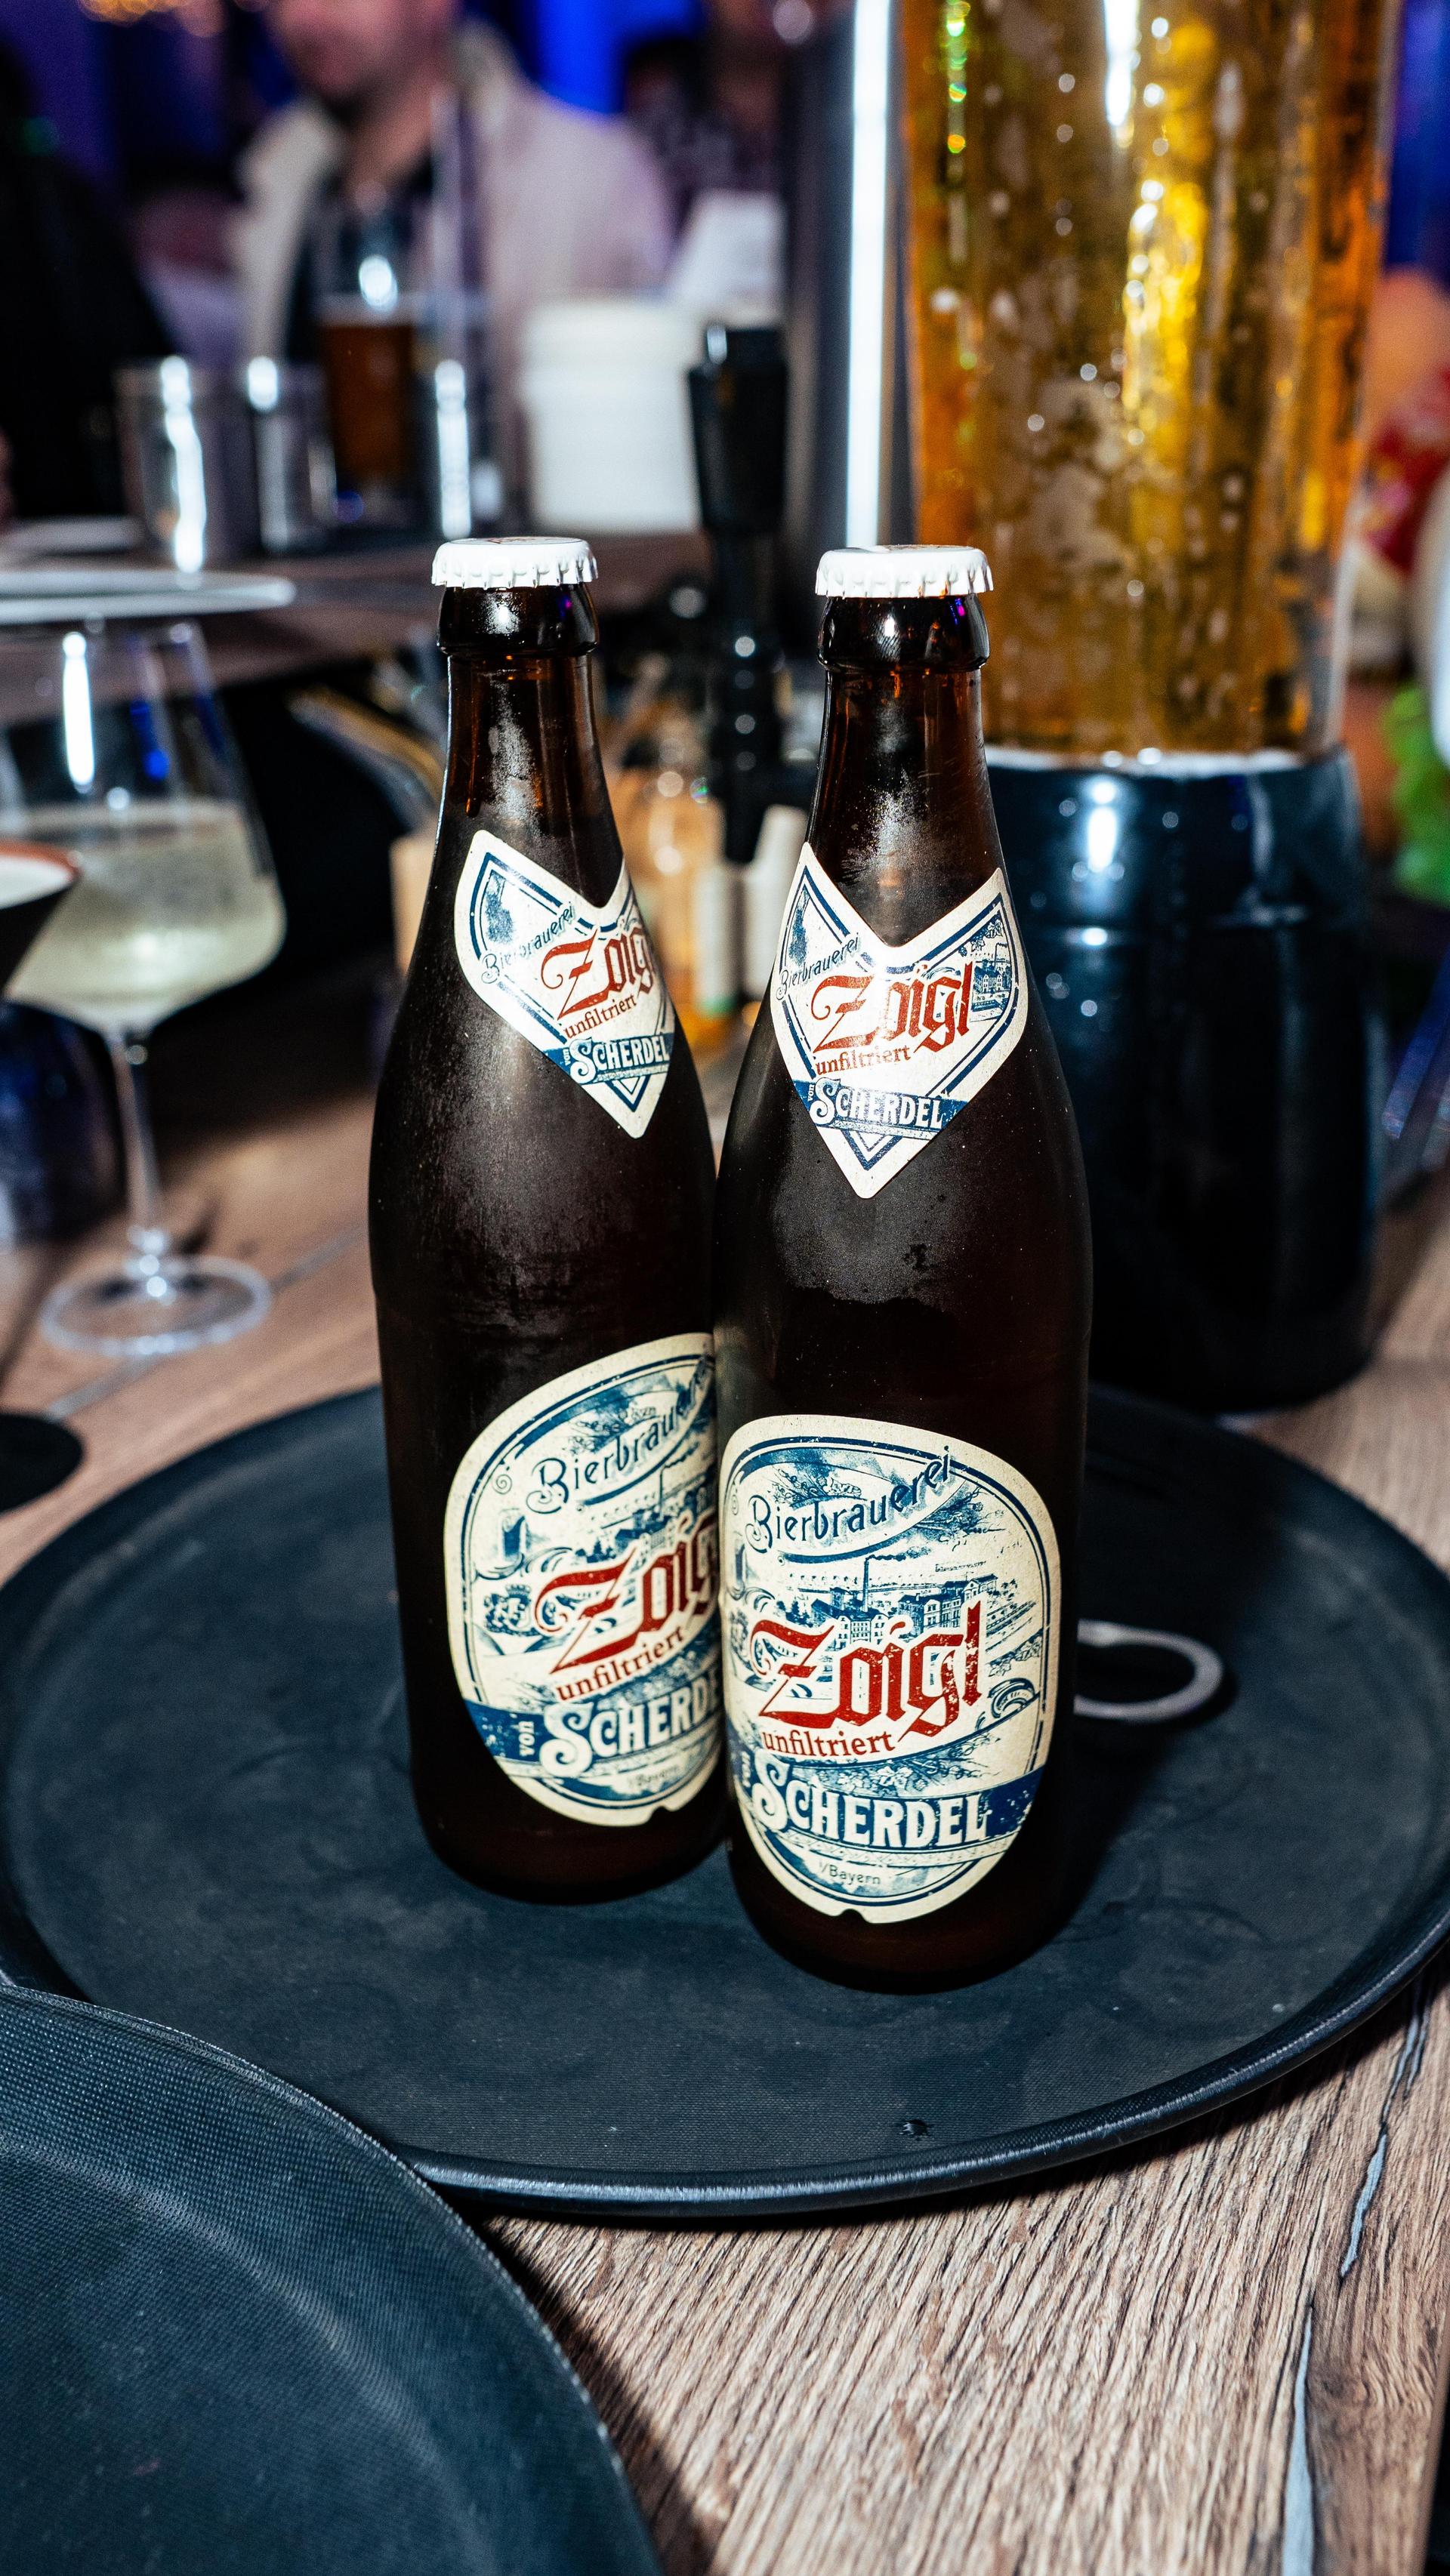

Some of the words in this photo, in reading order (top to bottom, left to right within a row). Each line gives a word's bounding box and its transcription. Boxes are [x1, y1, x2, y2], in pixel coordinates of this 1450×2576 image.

[776, 932, 859, 1000] Bierbrauerei
[565, 995, 637, 1040] unfiltriert
[810, 960, 973, 1054] Zoigl
[569, 1037, 670, 1084] SCHERDEL
[816, 1044, 912, 1075] unfiltriert
[809, 1077, 943, 1130] SCHERDEL
[745, 1445, 950, 1554] Bierbrauerei
[534, 1511, 717, 1675] Zoig
[556, 1626, 683, 1703] unfiltriert
[750, 1600, 983, 1737] Zoigl
[518, 1721, 535, 1756] von
[762, 1730, 896, 1758] unfiltriert
[752, 1746, 992, 1849] SCHERDEL
